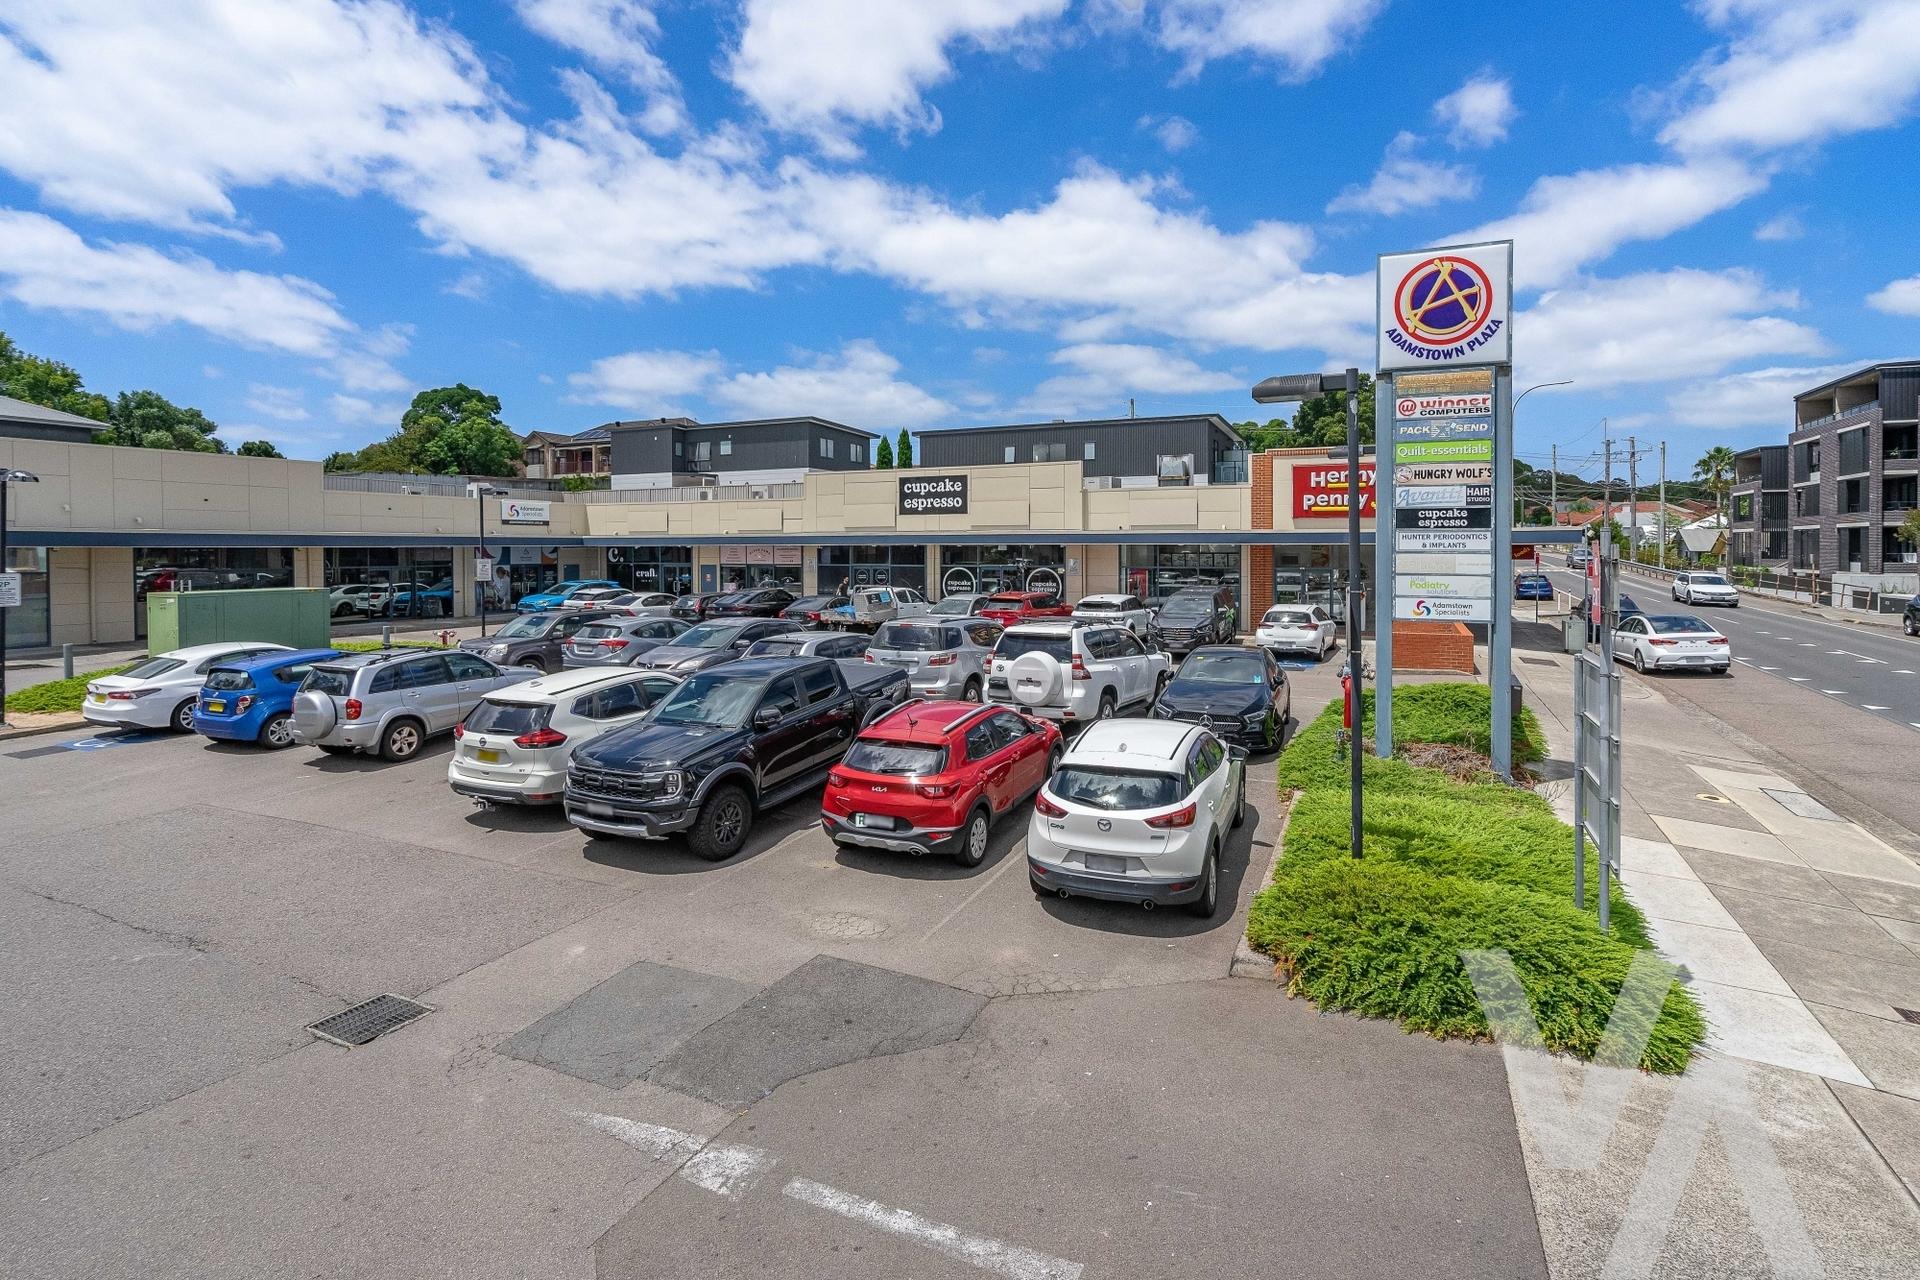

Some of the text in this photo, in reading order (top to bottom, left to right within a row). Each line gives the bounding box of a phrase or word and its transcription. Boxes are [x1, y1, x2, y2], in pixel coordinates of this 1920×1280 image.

[1385, 318, 1503, 361] ADAMSTOWN PLAZA
[1420, 396, 1490, 409] winner
[1420, 406, 1490, 416] COMPUTERS
[1399, 423, 1488, 435] PACK SEND
[1398, 443, 1488, 457] Quilt-essentials
[1413, 467, 1492, 480] HUNGRY WOLF'S
[903, 478, 962, 495] cupcake
[1466, 487, 1490, 496] HAIR
[903, 496, 962, 511] espresso
[1418, 509, 1468, 519] cupcake
[1418, 519, 1468, 529] espresso
[1409, 580, 1450, 590] Podiatry
[1434, 608, 1470, 617] Specialists
